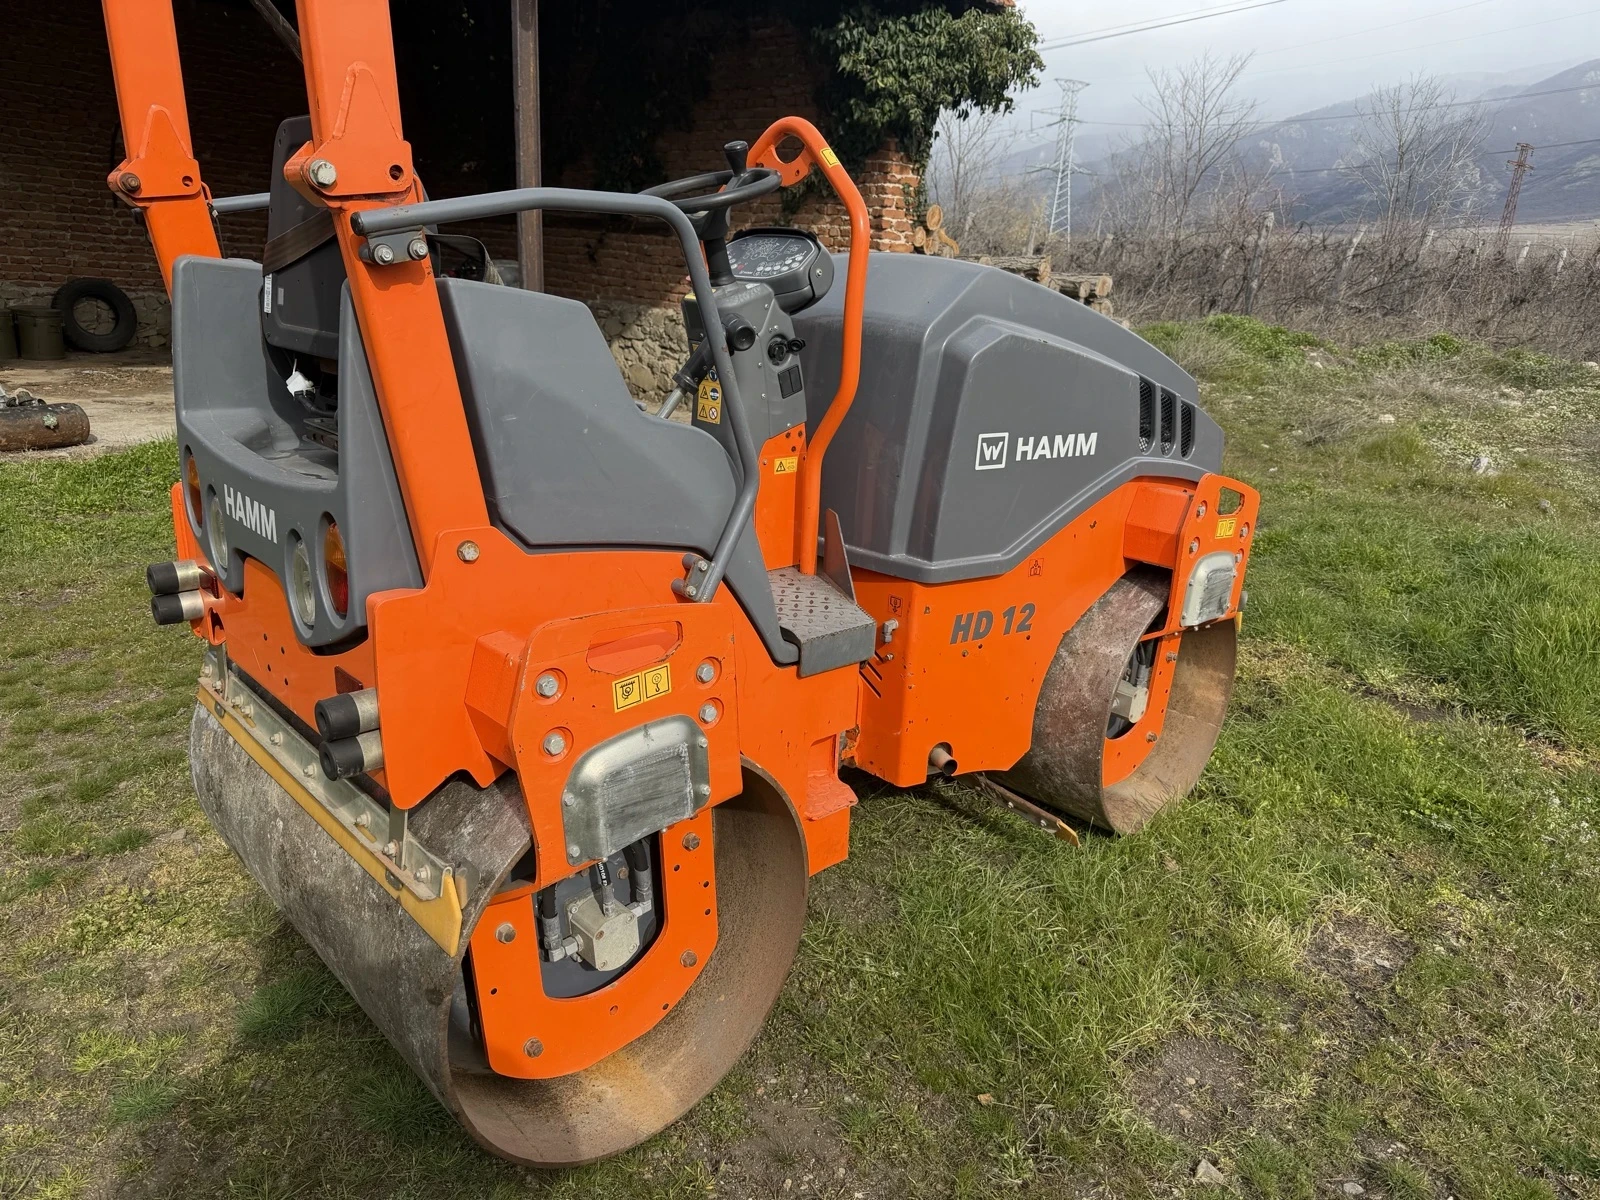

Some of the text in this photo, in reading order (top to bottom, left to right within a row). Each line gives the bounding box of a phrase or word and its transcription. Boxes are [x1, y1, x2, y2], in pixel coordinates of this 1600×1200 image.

[1015, 432, 1098, 462] HAMM
[223, 483, 278, 544] HAMM
[949, 602, 1036, 645] HD 12
